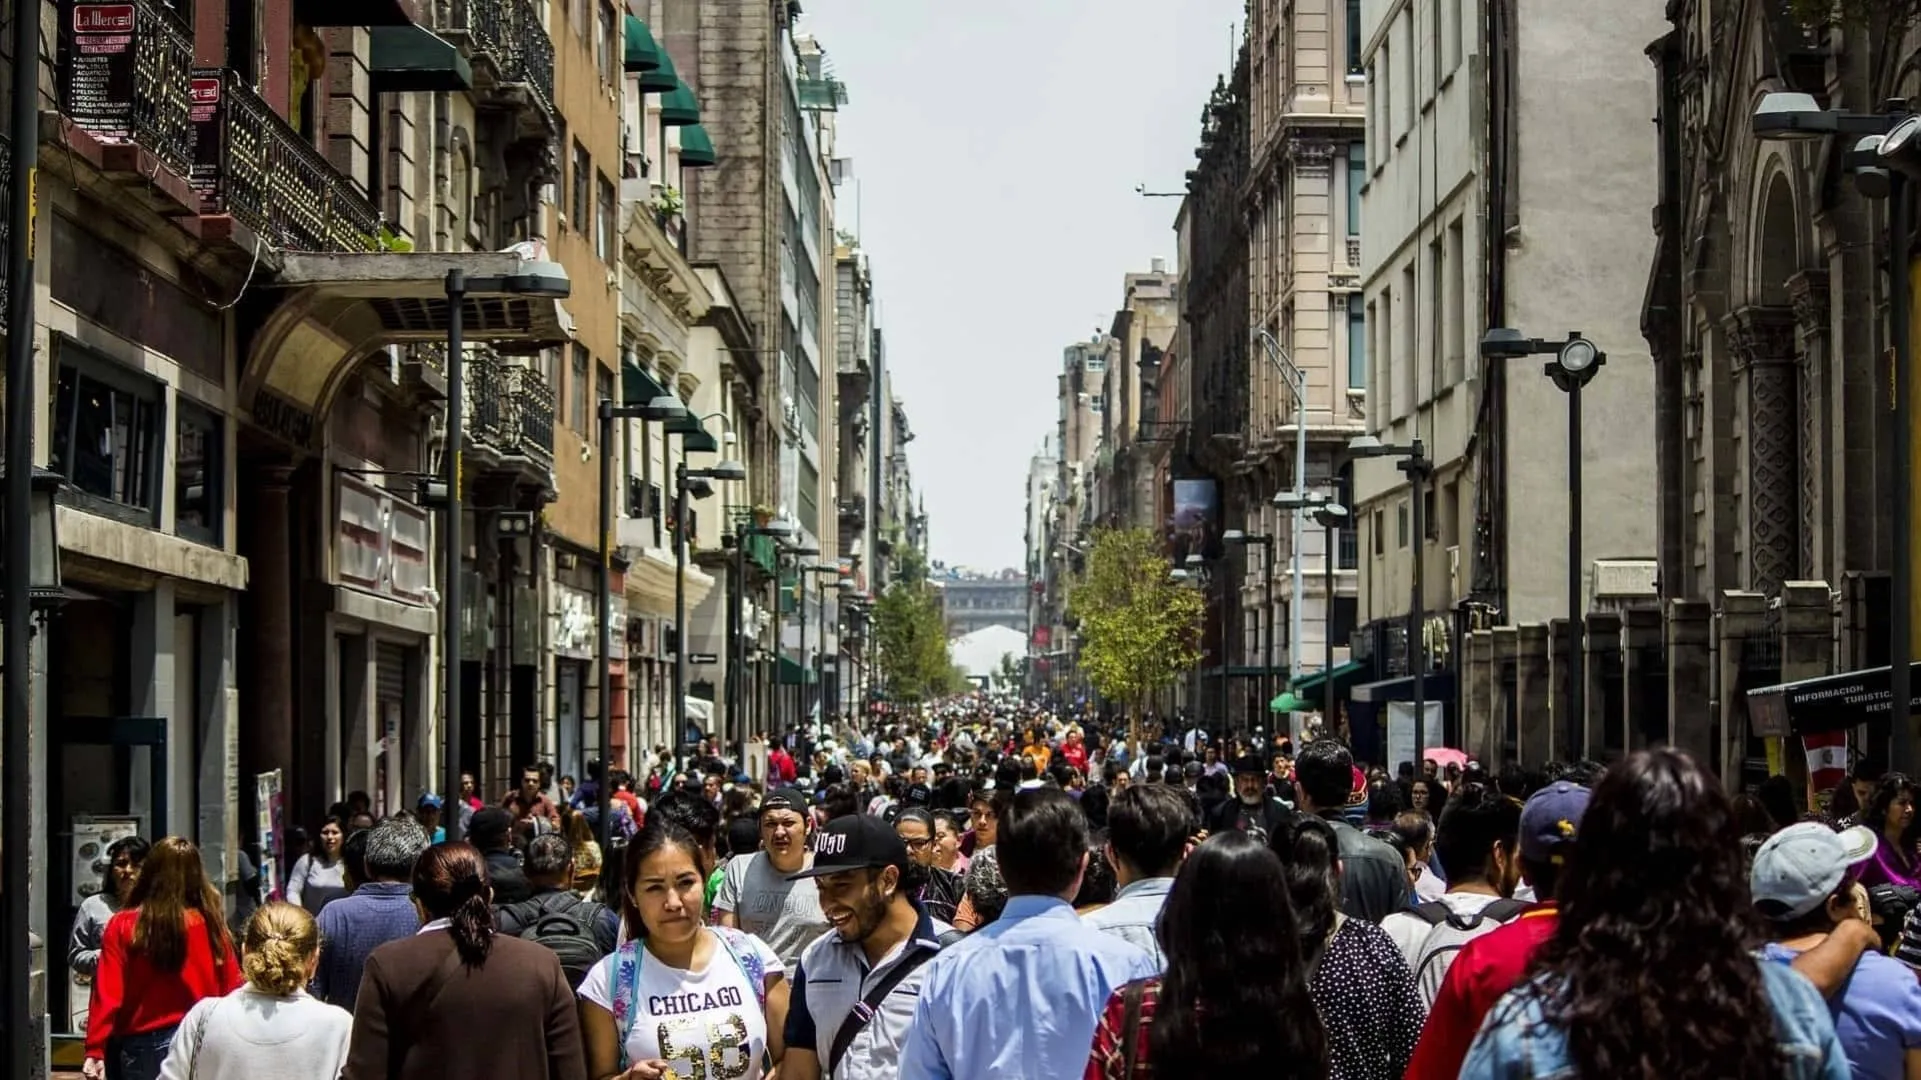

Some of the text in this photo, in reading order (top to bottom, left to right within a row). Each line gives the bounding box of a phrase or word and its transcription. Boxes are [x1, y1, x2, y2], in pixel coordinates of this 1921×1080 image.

[77, 13, 89, 26] La
[1794, 685, 1864, 703] INFORMACION
[1844, 690, 1892, 704] TURISTIC
[649, 986, 742, 1016] CHICAGO
